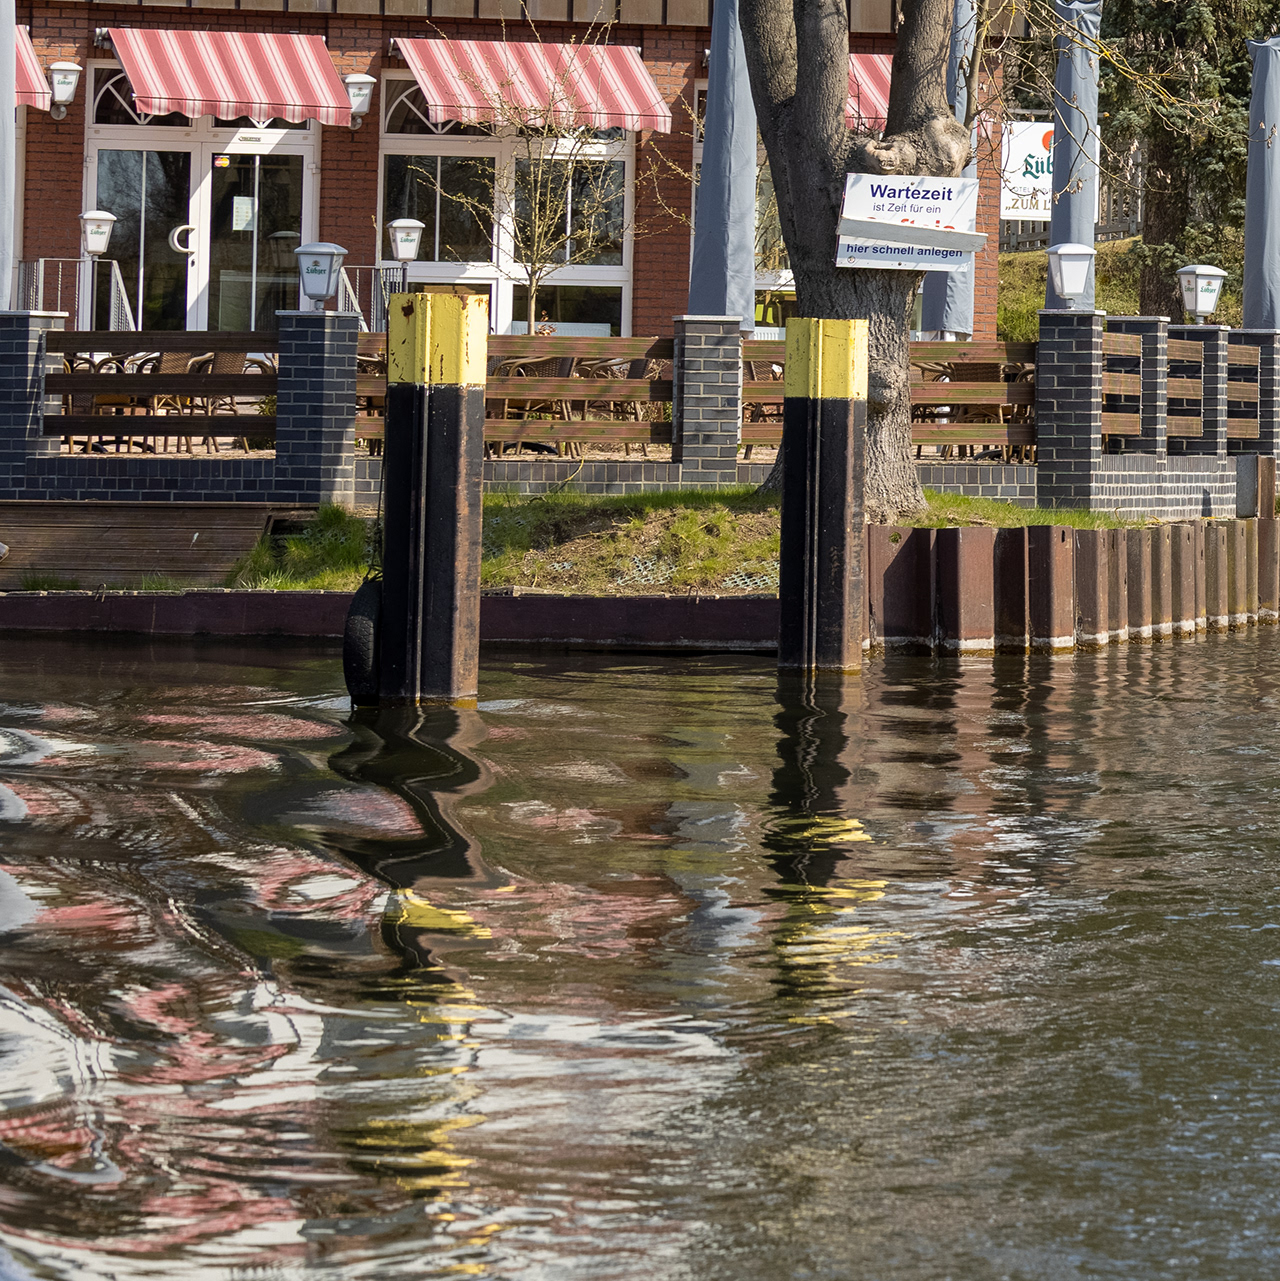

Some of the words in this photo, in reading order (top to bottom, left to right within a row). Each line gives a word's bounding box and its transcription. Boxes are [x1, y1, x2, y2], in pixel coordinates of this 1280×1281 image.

[870, 184, 953, 201] Wartezeit
[873, 203, 885, 212] ist
[887, 203, 907, 213] Zeit
[910, 204, 924, 213] für
[926, 205, 941, 214] ein
[846, 244, 869, 254] hier
[872, 245, 914, 256] schnell
[917, 246, 963, 259] anlegen
